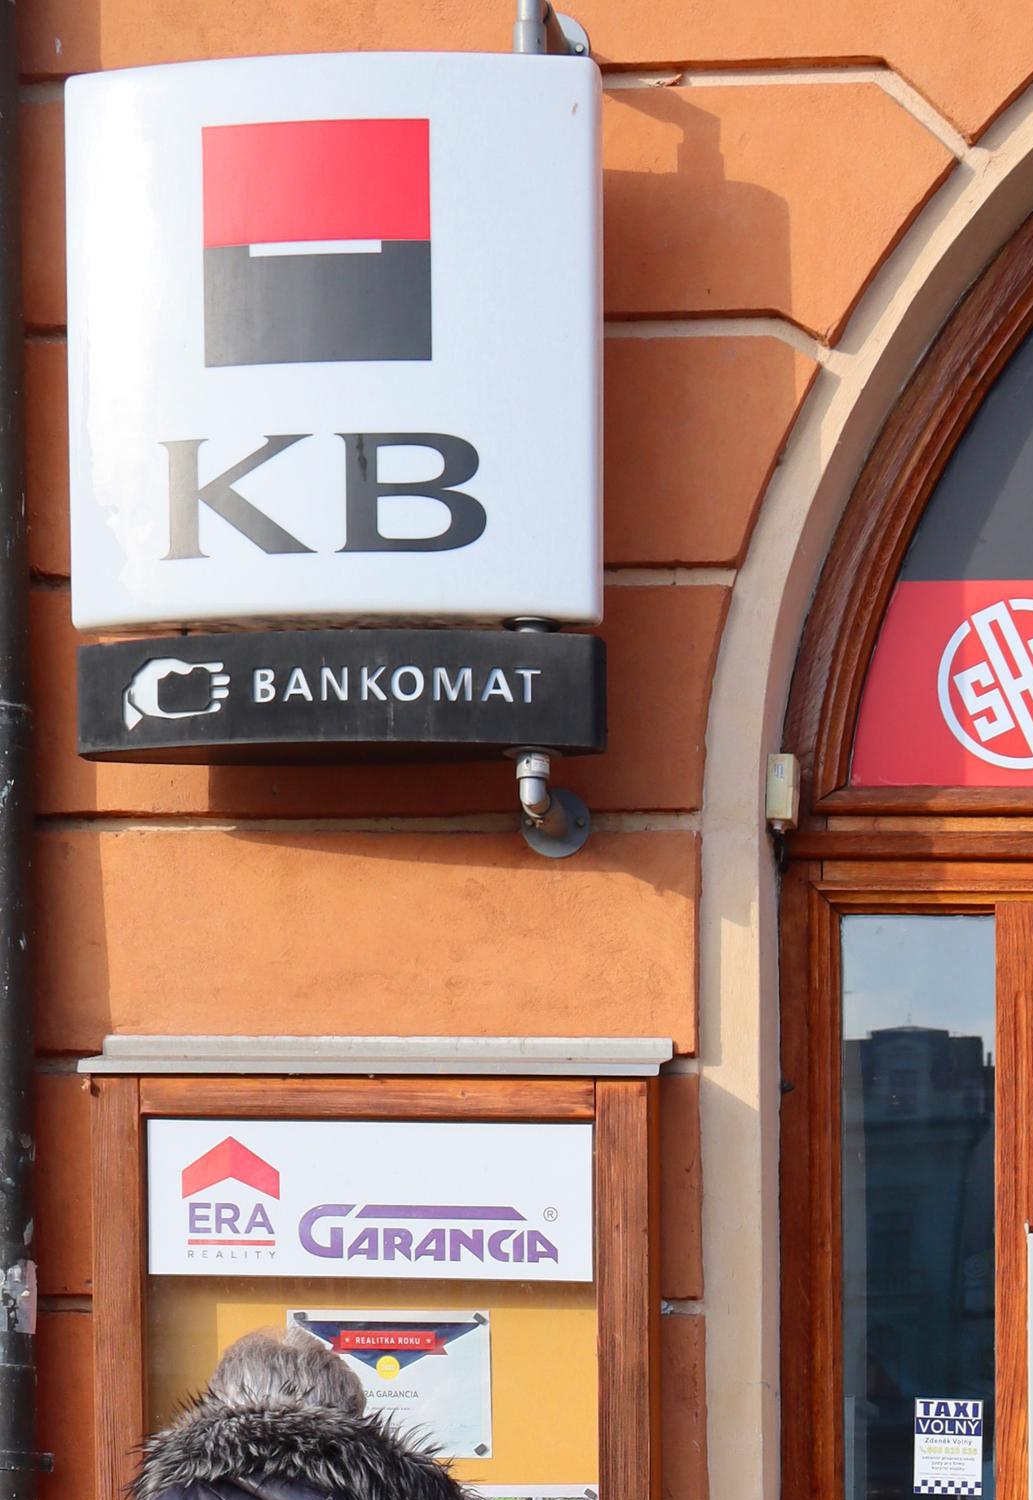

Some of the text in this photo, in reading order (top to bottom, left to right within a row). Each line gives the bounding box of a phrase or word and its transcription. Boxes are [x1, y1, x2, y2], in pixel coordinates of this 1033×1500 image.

[159, 432, 488, 561] KB
[252, 666, 542, 705] BANKOMAT
[188, 1202, 276, 1234] ERA
[187, 1250, 277, 1259] REALITY
[355, 1336, 421, 1345] REALITKA ROKU
[376, 1390, 419, 1399] GARANCIA
[919, 1401, 980, 1417] TAXI
[918, 1419, 980, 1434] VOLNÝ
